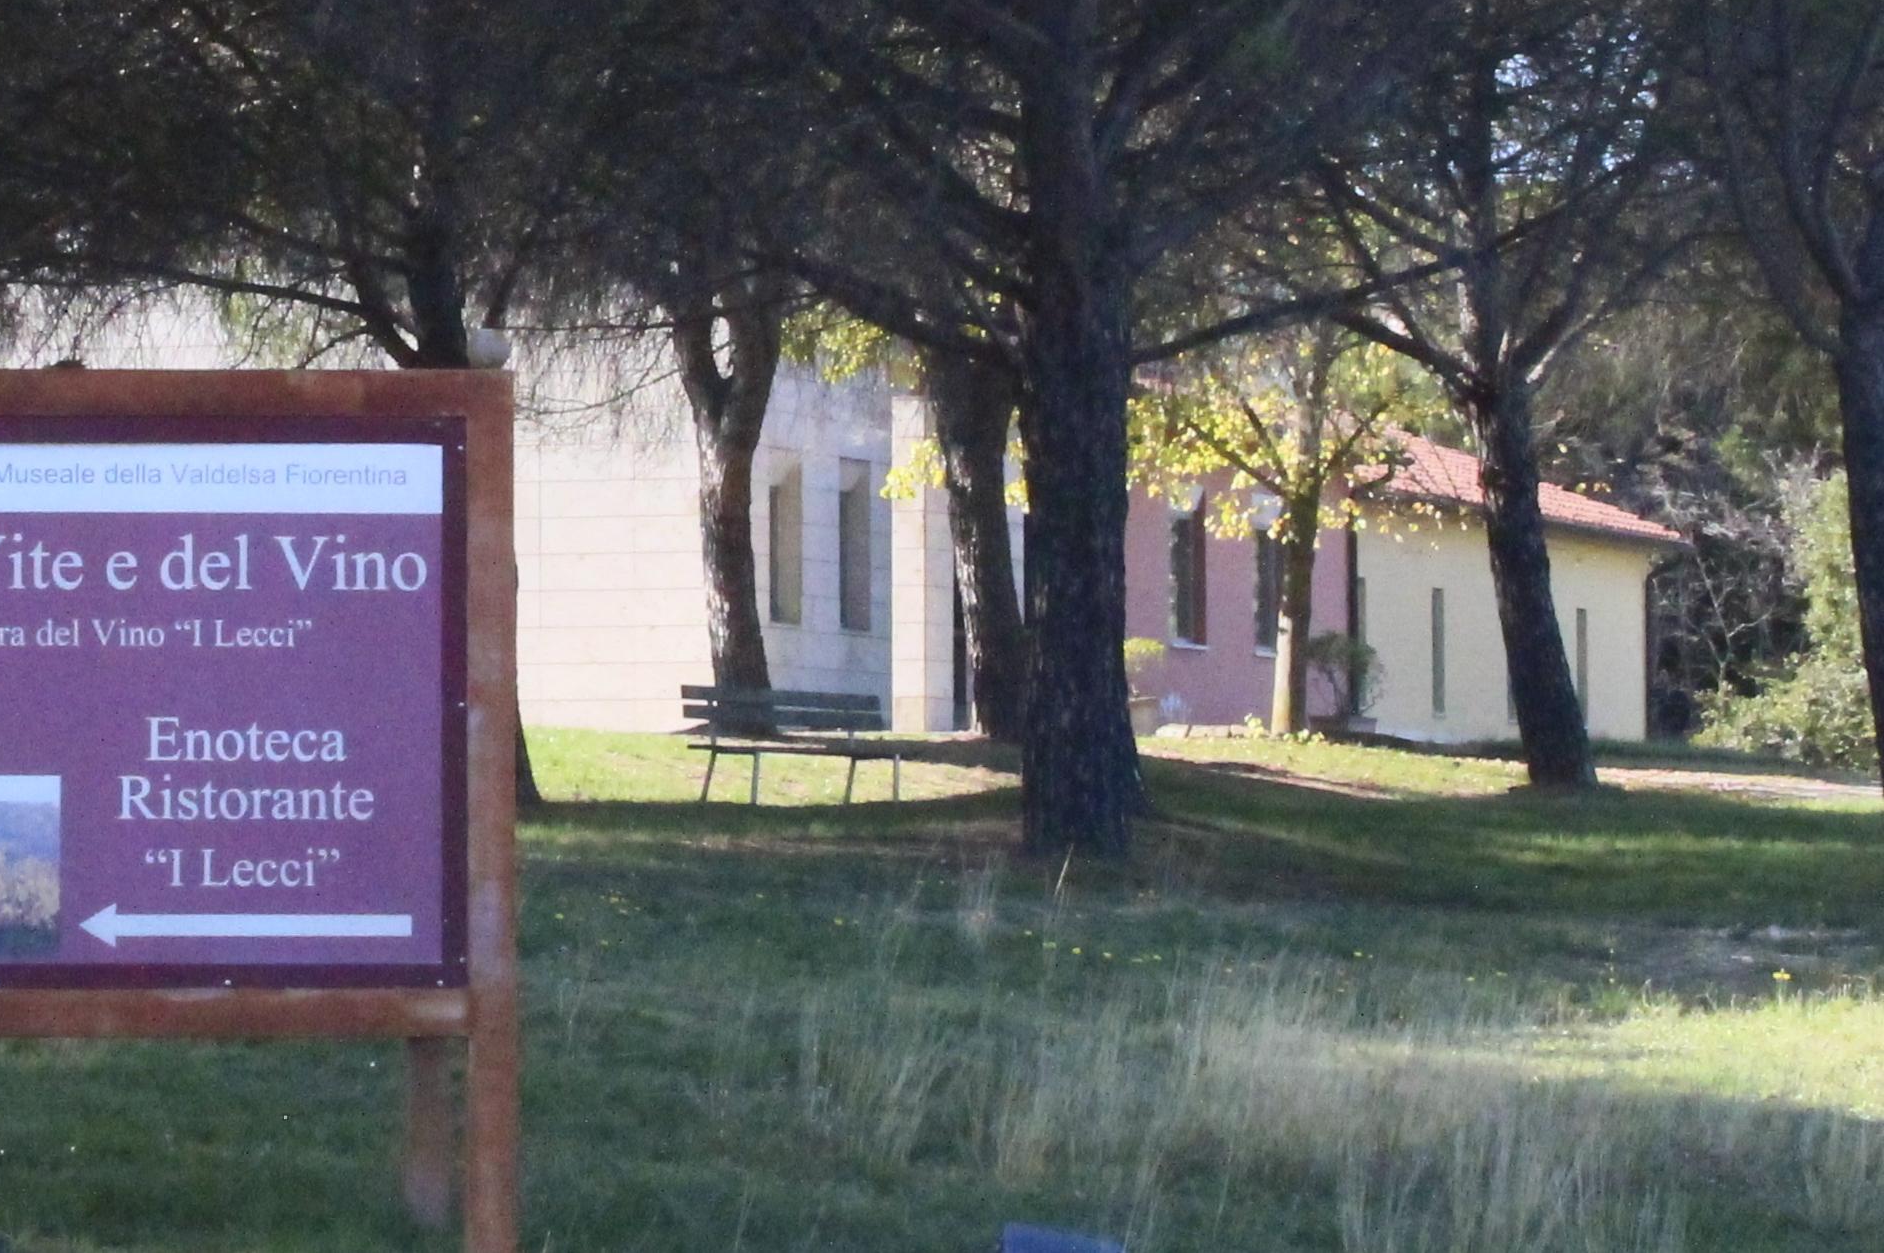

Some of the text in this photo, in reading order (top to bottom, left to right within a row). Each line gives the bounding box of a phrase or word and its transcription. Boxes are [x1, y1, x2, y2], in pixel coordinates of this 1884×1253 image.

[105, 463, 163, 486] della
[172, 463, 277, 486] Valdelsa
[286, 463, 408, 487] Fiorentina
[107, 552, 139, 592] e
[160, 534, 254, 592] del
[275, 534, 429, 593] Vino
[36, 619, 81, 648] del
[91, 619, 166, 649] Vino
[146, 717, 349, 764] Enoteca
[118, 774, 376, 822] Ristorante
